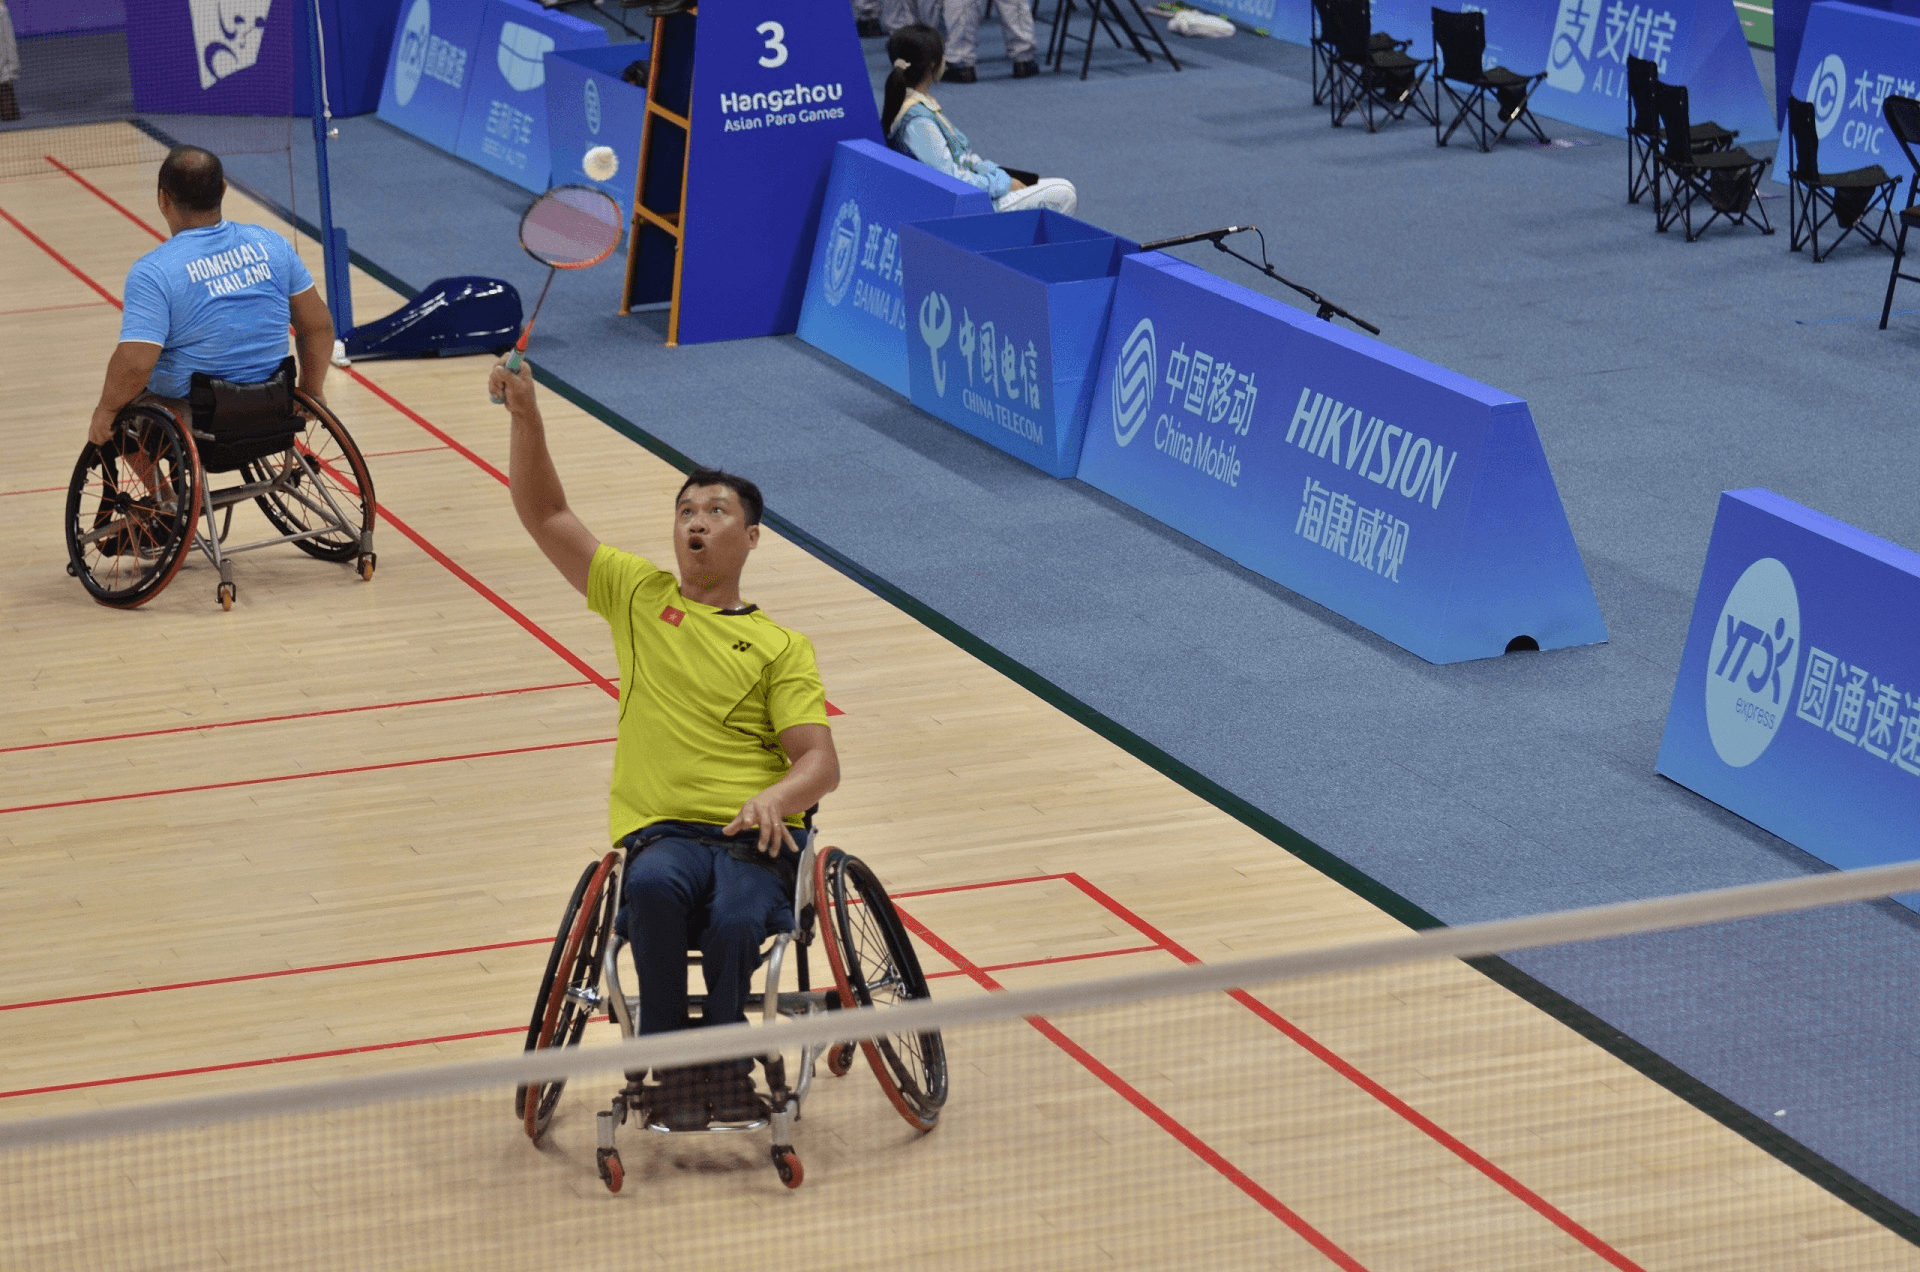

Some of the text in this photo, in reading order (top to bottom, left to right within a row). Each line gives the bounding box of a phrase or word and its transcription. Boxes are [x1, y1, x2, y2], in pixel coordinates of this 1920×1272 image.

[756, 21, 788, 68] 3
[1596, 0, 1676, 74] 支付宝
[720, 82, 842, 114] Hangzhou
[1592, 65, 1629, 101] ALI
[724, 107, 845, 132] Asian Para Games
[1842, 119, 1884, 155] CPIC
[205, 262, 271, 297] THAILAND
[853, 279, 891, 322] BANMA
[958, 306, 1041, 411] 中国电信
[1165, 341, 1258, 437] 中国移动
[962, 388, 1044, 446] CHINA TELECOM
[1154, 413, 1241, 488] China Mobile
[1284, 386, 1458, 510] HIKVISION
[1294, 476, 1410, 584] 海康威视
[1735, 697, 1777, 730] express
